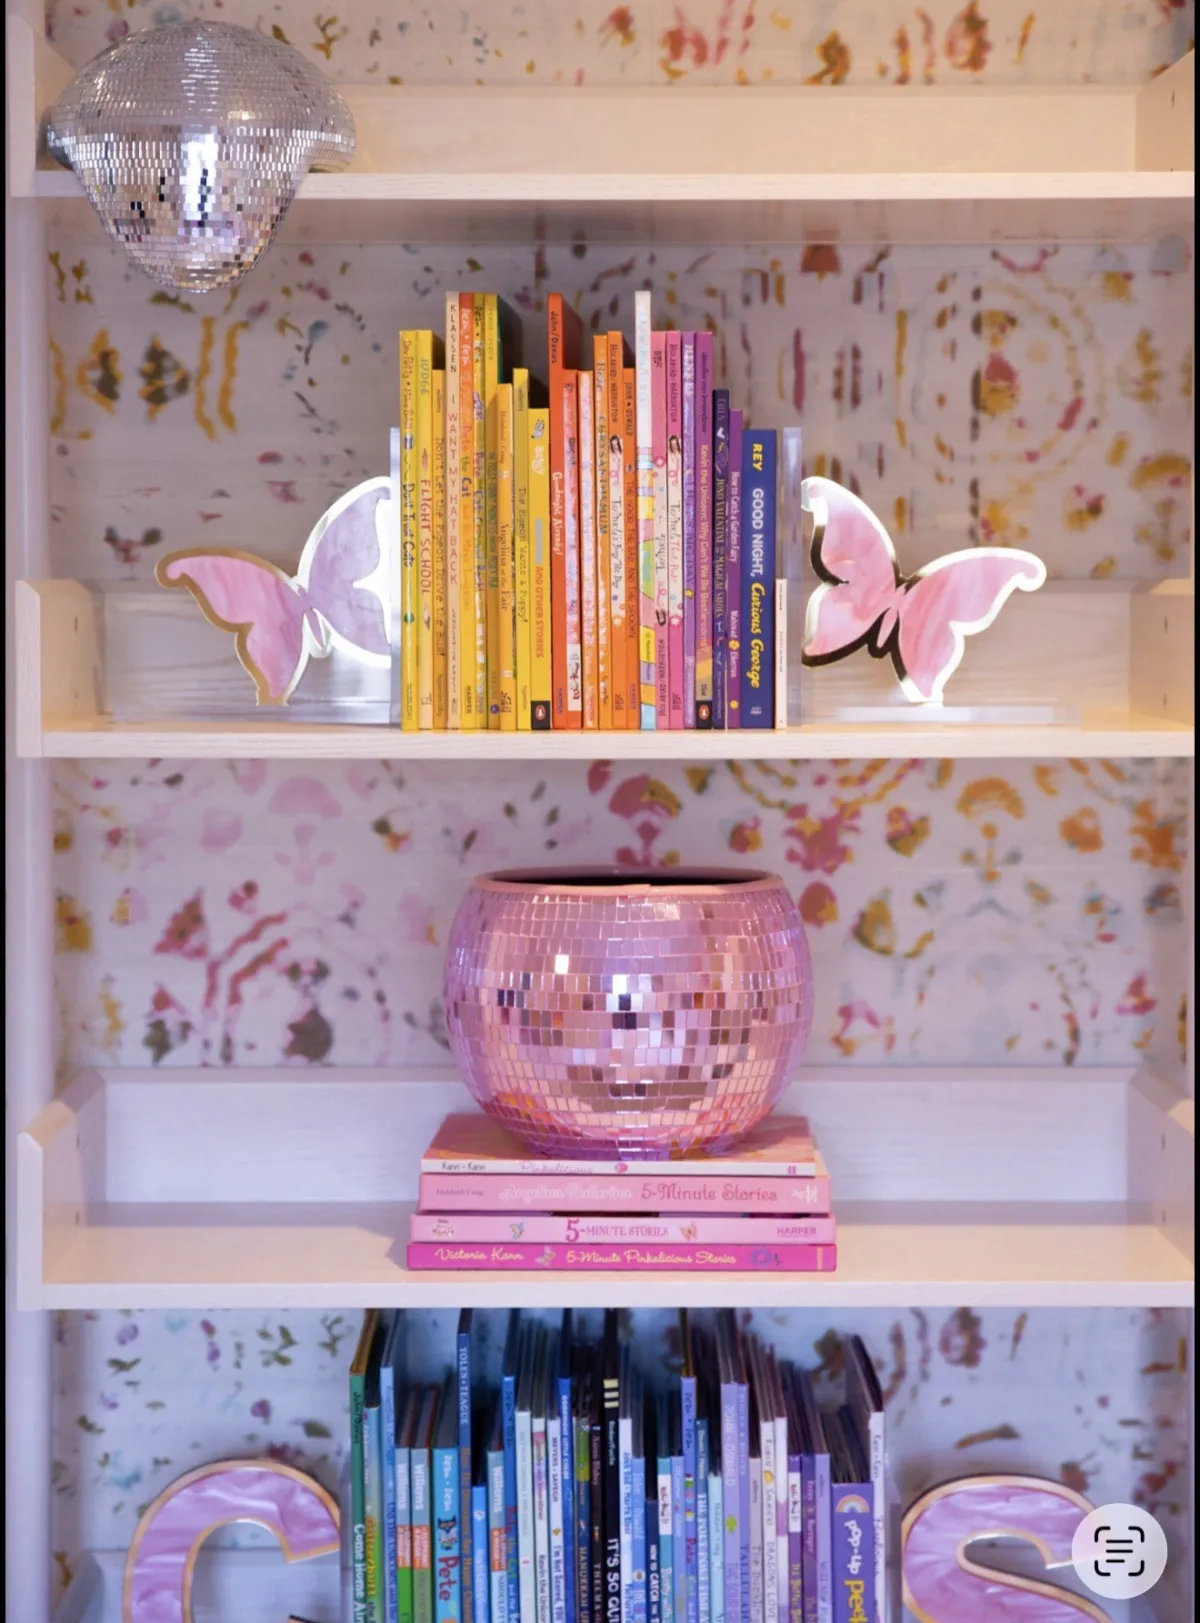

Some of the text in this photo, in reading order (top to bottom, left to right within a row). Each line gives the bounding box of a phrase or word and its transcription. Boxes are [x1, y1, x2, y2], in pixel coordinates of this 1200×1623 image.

[420, 356, 429, 396] JUDGE
[700, 444, 708, 467] Kevin
[752, 442, 763, 472] REY
[436, 475, 445, 495] Let
[462, 477, 472, 498] Cat
[700, 469, 708, 484] the
[731, 471, 740, 486] How
[450, 412, 458, 586] WANT MY HAT BACK
[518, 487, 527, 504] The
[626, 481, 634, 496] THE
[718, 478, 726, 500] JUNO
[731, 487, 740, 495] to
[436, 499, 445, 518] the
[731, 496, 740, 514] Catch
[403, 511, 416, 539] Trust
[518, 509, 527, 542] Pigeon
[700, 522, 708, 540] Why
[716, 501, 726, 544] VALENTINE
[731, 520, 740, 545] Garden
[420, 478, 431, 596] FLIGHT SCHOOL
[434, 524, 444, 563] Pigeon
[552, 518, 563, 555] Already!
[627, 528, 635, 543] THE
[403, 540, 416, 568] Cats
[518, 545, 527, 576] Wants
[627, 546, 635, 562] BAD
[700, 541, 708, 564] Can't
[730, 546, 739, 562] Fairy
[499, 522, 509, 611] Angelina Fair
[627, 566, 635, 584] AND
[700, 565, 708, 578] We
[716, 556, 724, 592] MAGICAL
[436, 568, 445, 602] Drive
[627, 586, 635, 602] THE
[700, 580, 708, 591] Be
[746, 488, 766, 688] GOOD NIGHT, Curious George
[436, 607, 445, 626] the
[535, 566, 545, 658] AND OTHER STORIES
[700, 592, 708, 653] Bestie-corns?
[730, 610, 738, 638] Walstead
[641, 1183, 716, 1201] 5-Minute
[722, 1184, 778, 1202] Stories
[628, 1226, 669, 1237] STORIES
[777, 1227, 817, 1236] HARPER
[435, 1247, 524, 1261] Victoria Kann
[566, 1248, 736, 1265] 5-Minute Pinkalicious Stories
[460, 1346, 468, 1425] YOLEN TEAGUE
[414, 1464, 426, 1510] Willems
[554, 1546, 562, 1558] I'm
[608, 1538, 620, 1568] IT'S
[752, 1545, 762, 1566] The
[844, 1520, 862, 1574] pop-up
[354, 1524, 366, 1598] Come Home
[554, 1560, 562, 1573] Not
[650, 1562, 658, 1571] TO
[438, 1556, 461, 1602] Pete
[579, 1546, 588, 1608] HANUKKAH
[594, 1562, 602, 1612] THELMA
[608, 1572, 620, 1592] SO
[650, 1573, 658, 1602] CATCH
[740, 1544, 749, 1620] TALLULAH
[766, 1541, 776, 1619] DRAGONS LOVE
